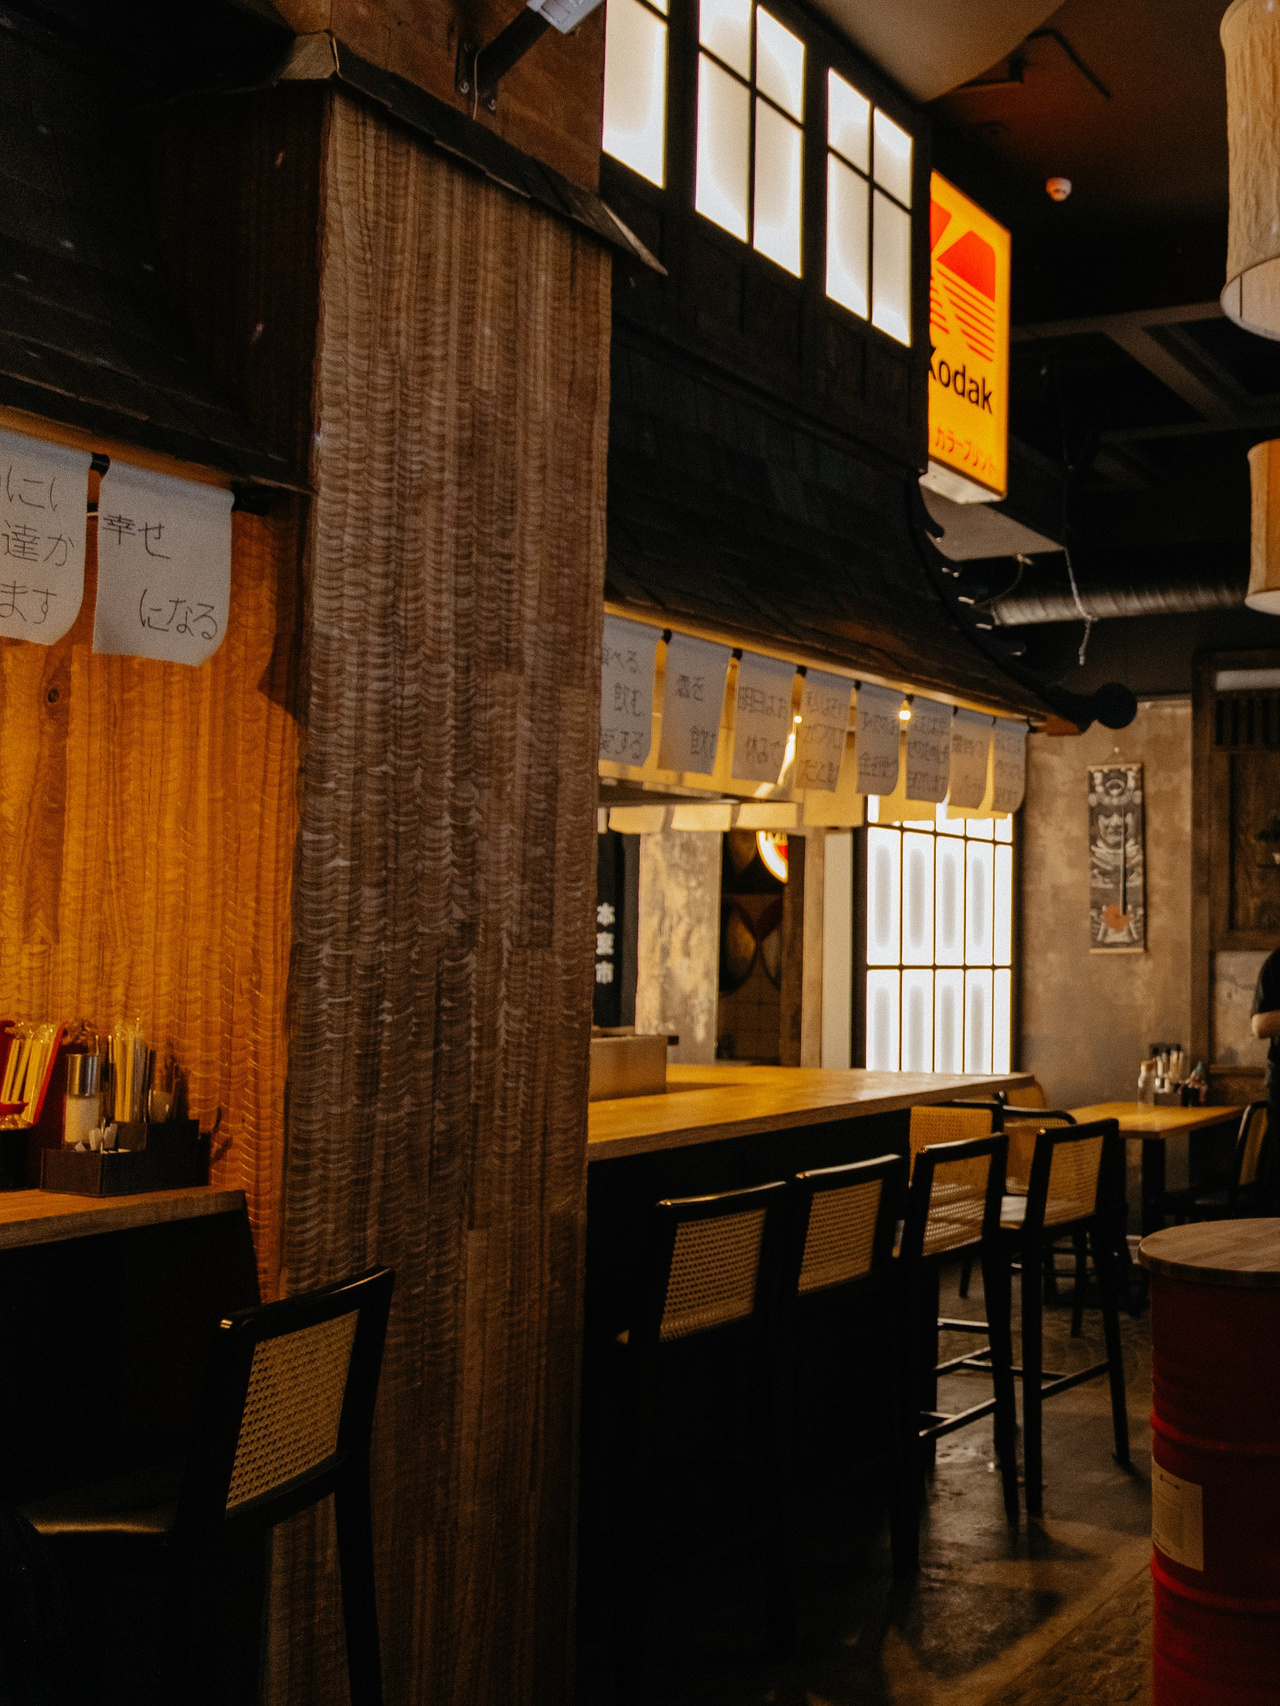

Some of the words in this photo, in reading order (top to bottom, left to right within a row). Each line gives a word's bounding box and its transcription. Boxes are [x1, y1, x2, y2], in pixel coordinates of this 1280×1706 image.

[932, 361, 993, 415] odak
[102, 514, 171, 560] 幸せ
[139, 588, 218, 640] になる
